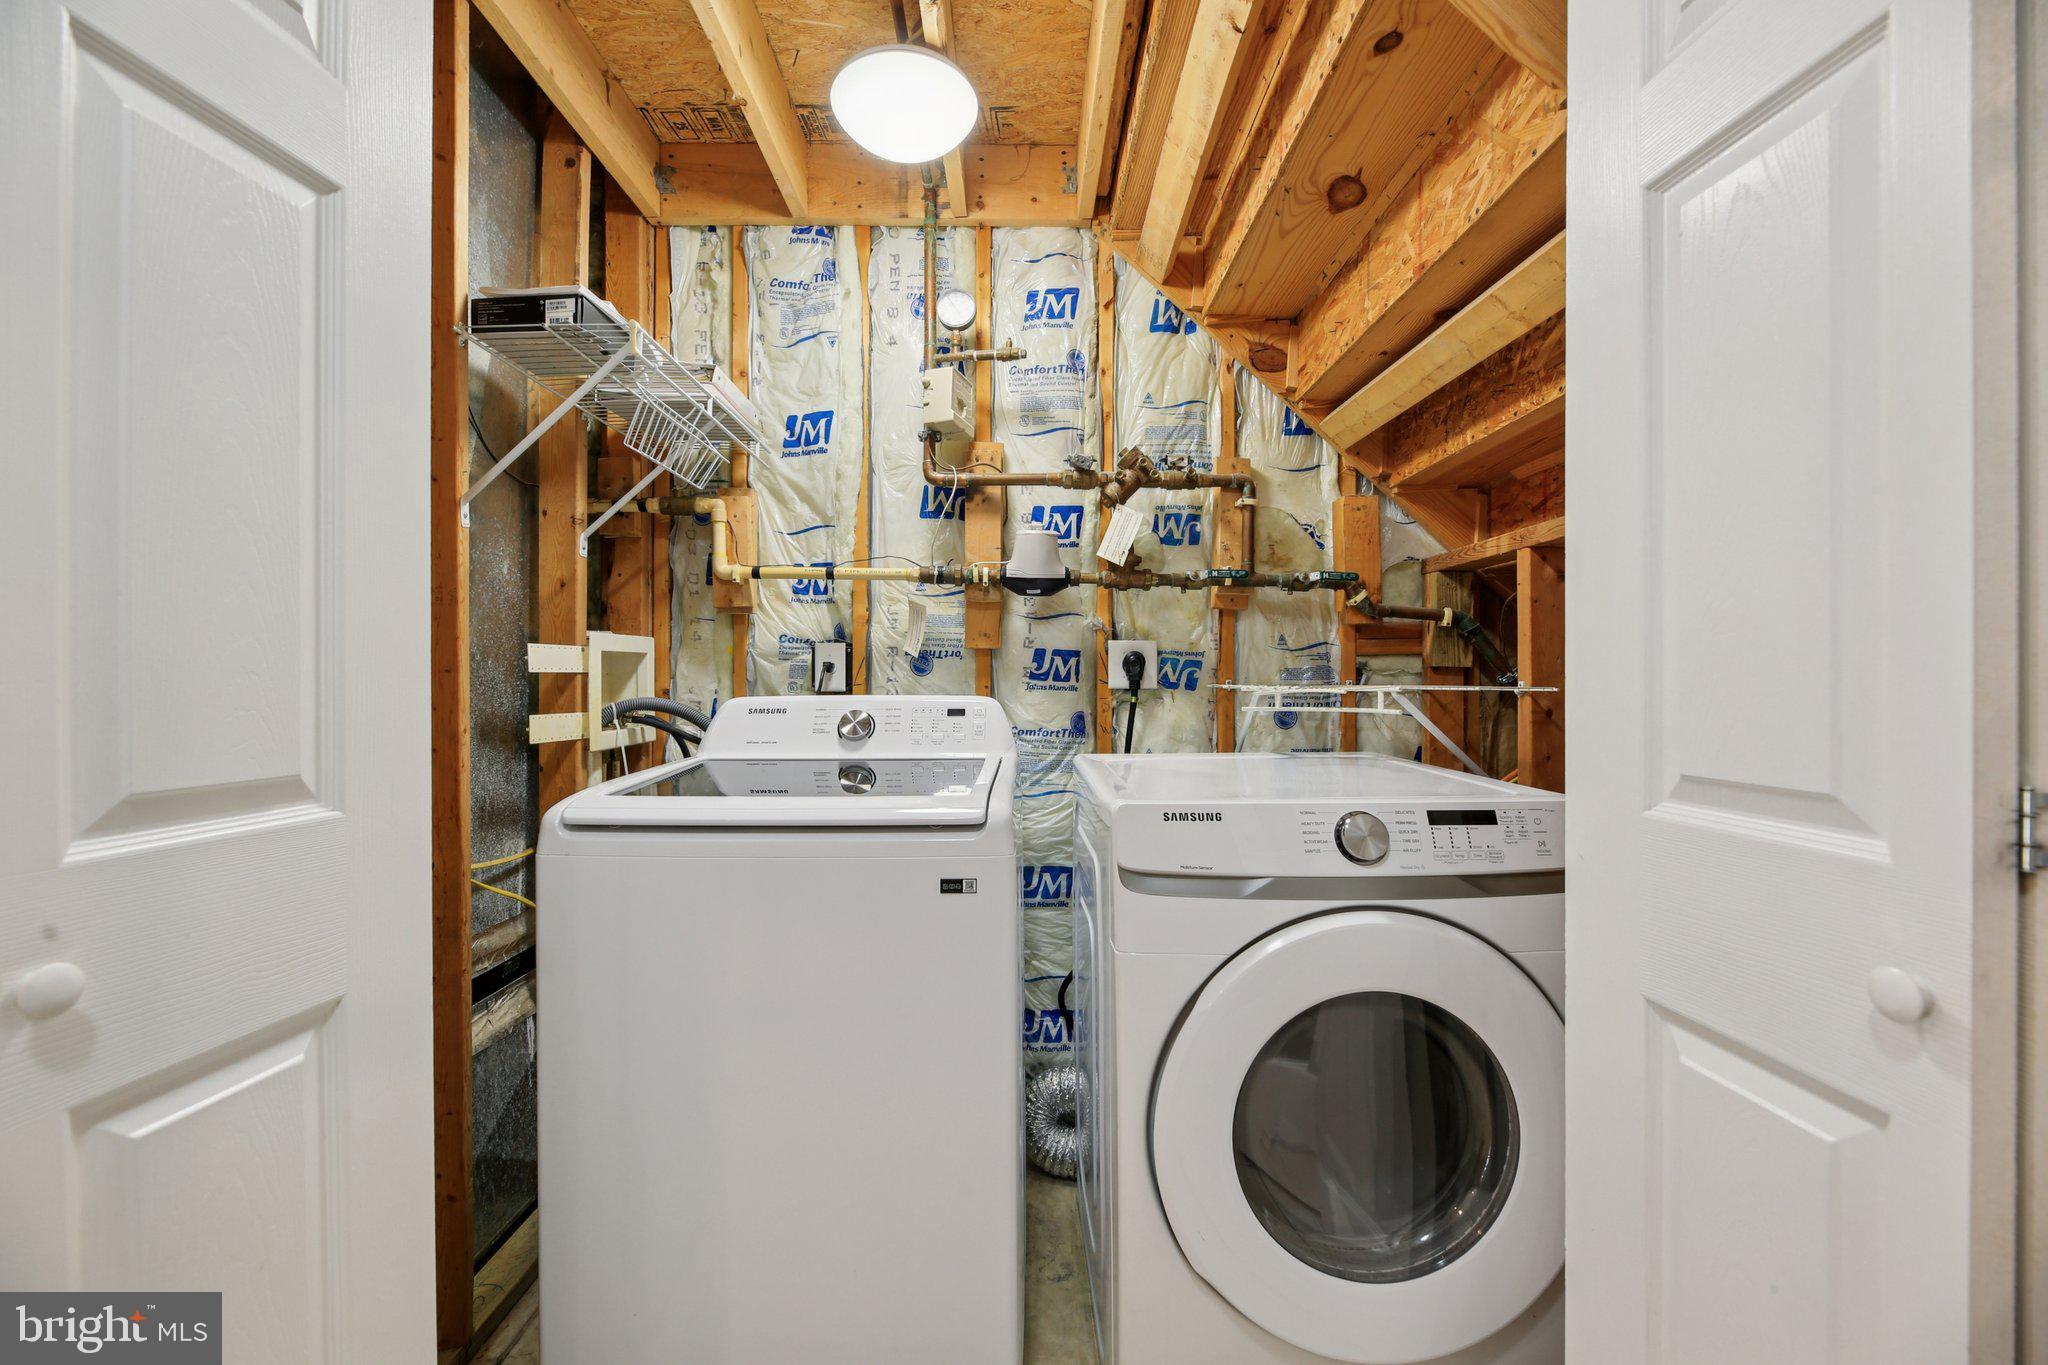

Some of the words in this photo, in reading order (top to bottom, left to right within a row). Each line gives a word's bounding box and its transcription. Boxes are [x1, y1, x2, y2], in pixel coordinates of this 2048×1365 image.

[1024, 287, 1080, 322] JM
[1043, 322, 1074, 330] Manville
[782, 410, 834, 448] JM
[801, 446, 828, 456] Manville
[1029, 648, 1081, 683] JM
[1163, 812, 1222, 822] SAMSUNG
